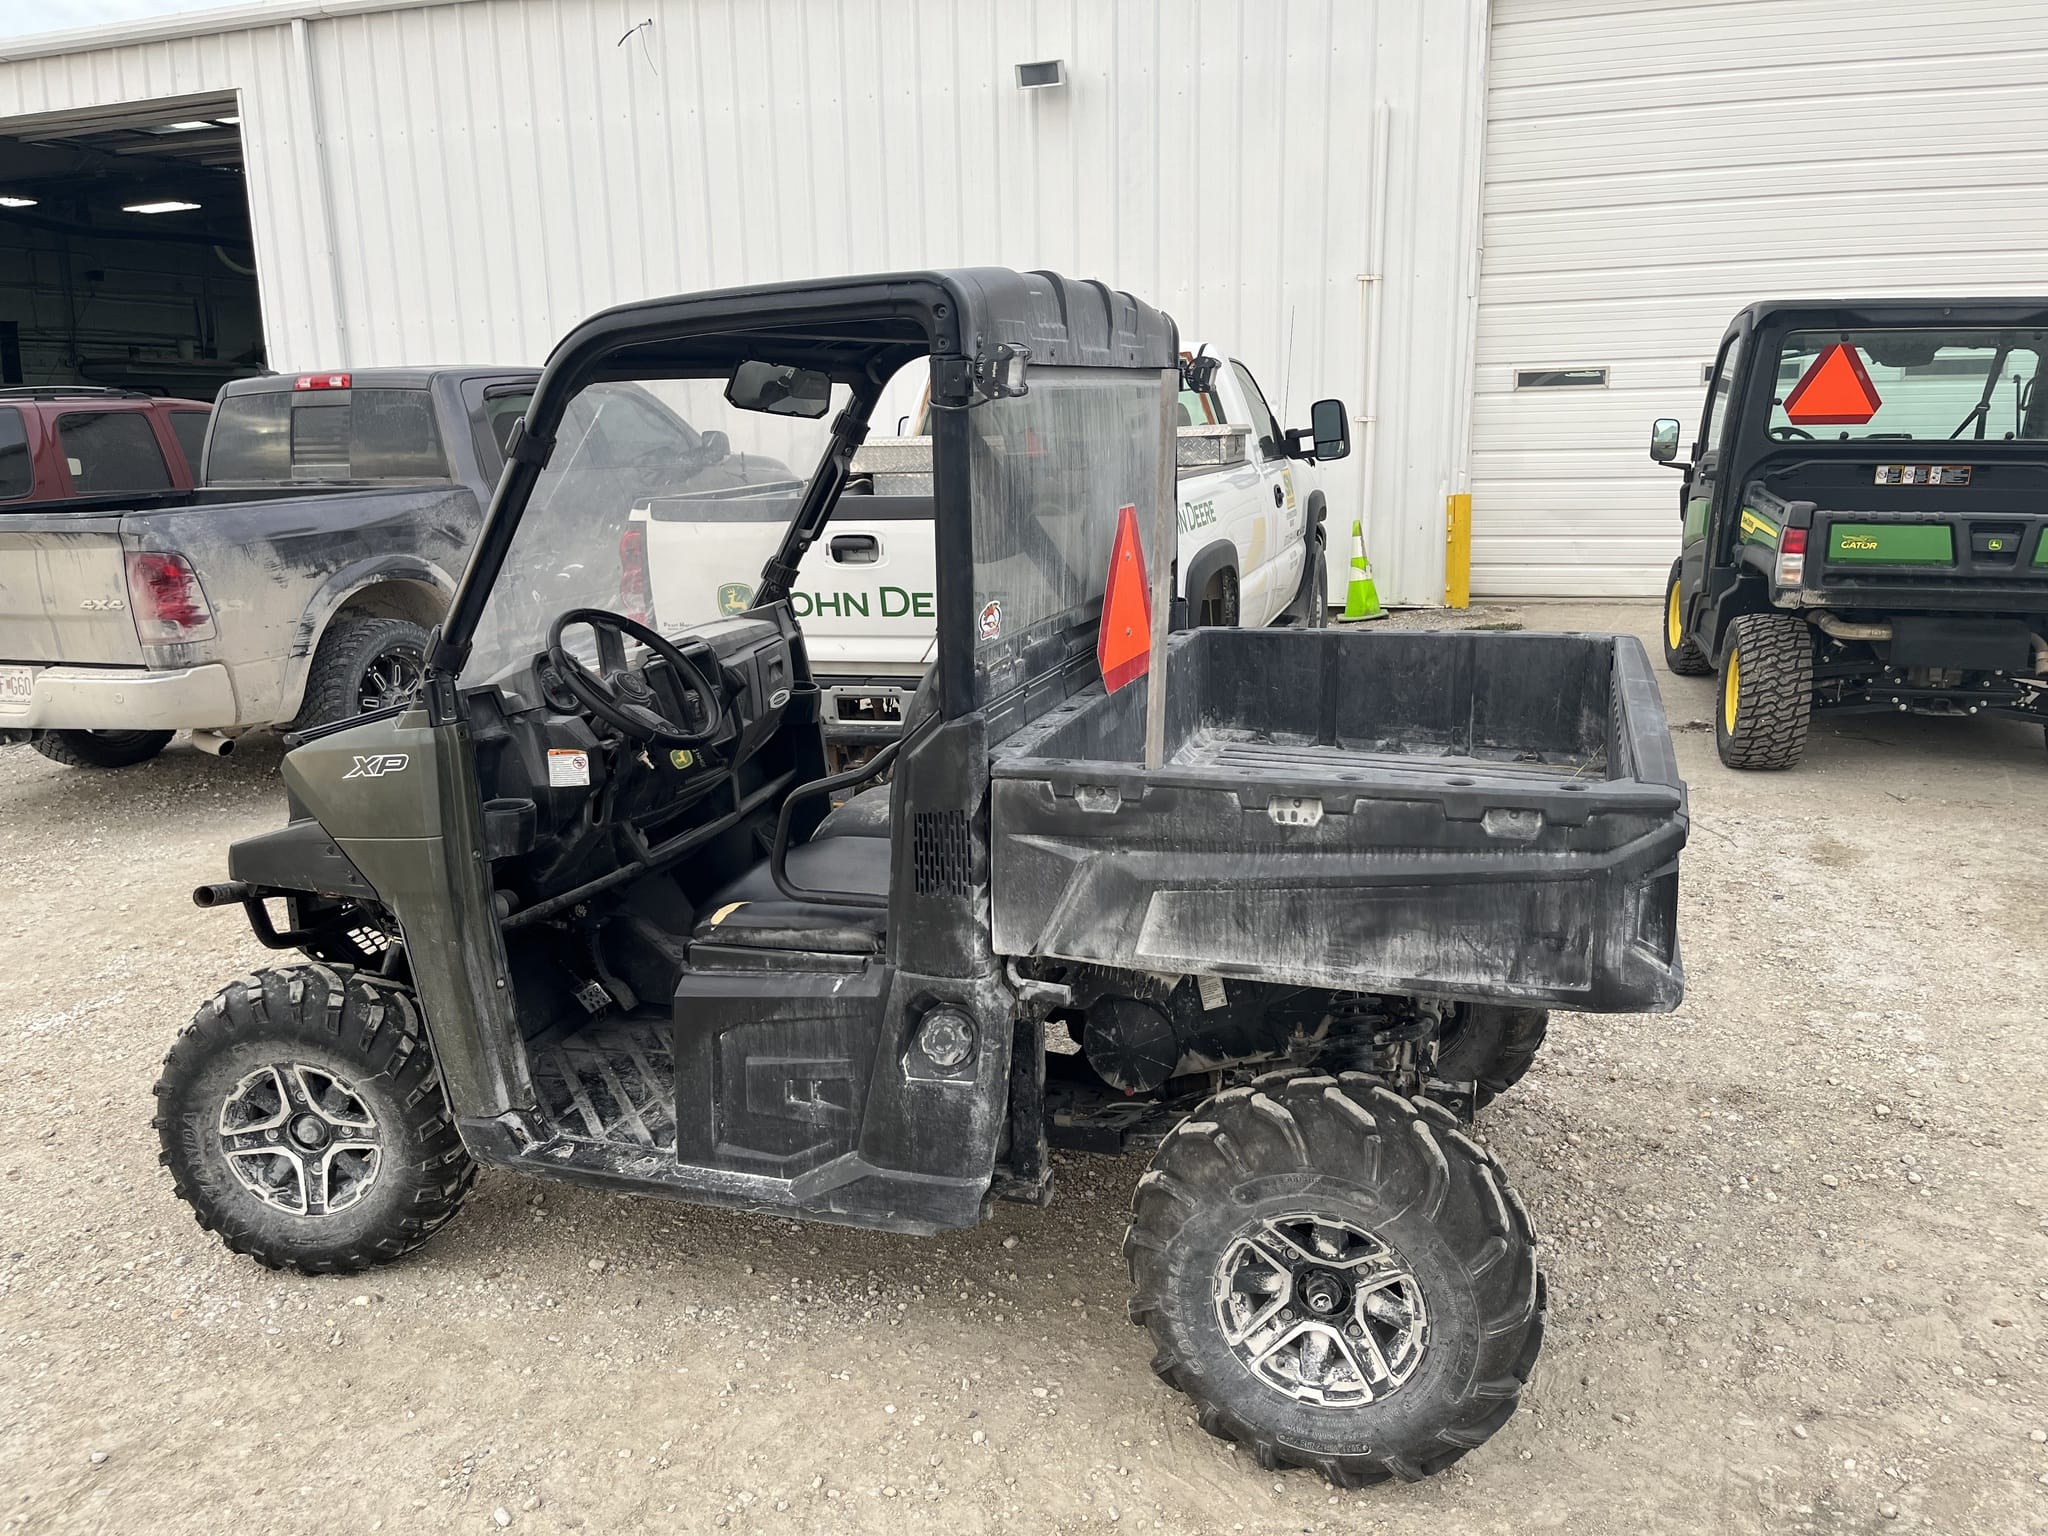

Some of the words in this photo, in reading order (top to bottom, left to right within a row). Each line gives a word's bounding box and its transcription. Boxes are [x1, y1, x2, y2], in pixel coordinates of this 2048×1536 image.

[1185, 500, 1217, 531] DEERE
[1841, 541, 1878, 550] GATOR
[790, 592, 869, 617] OHN
[342, 754, 409, 779] XP
